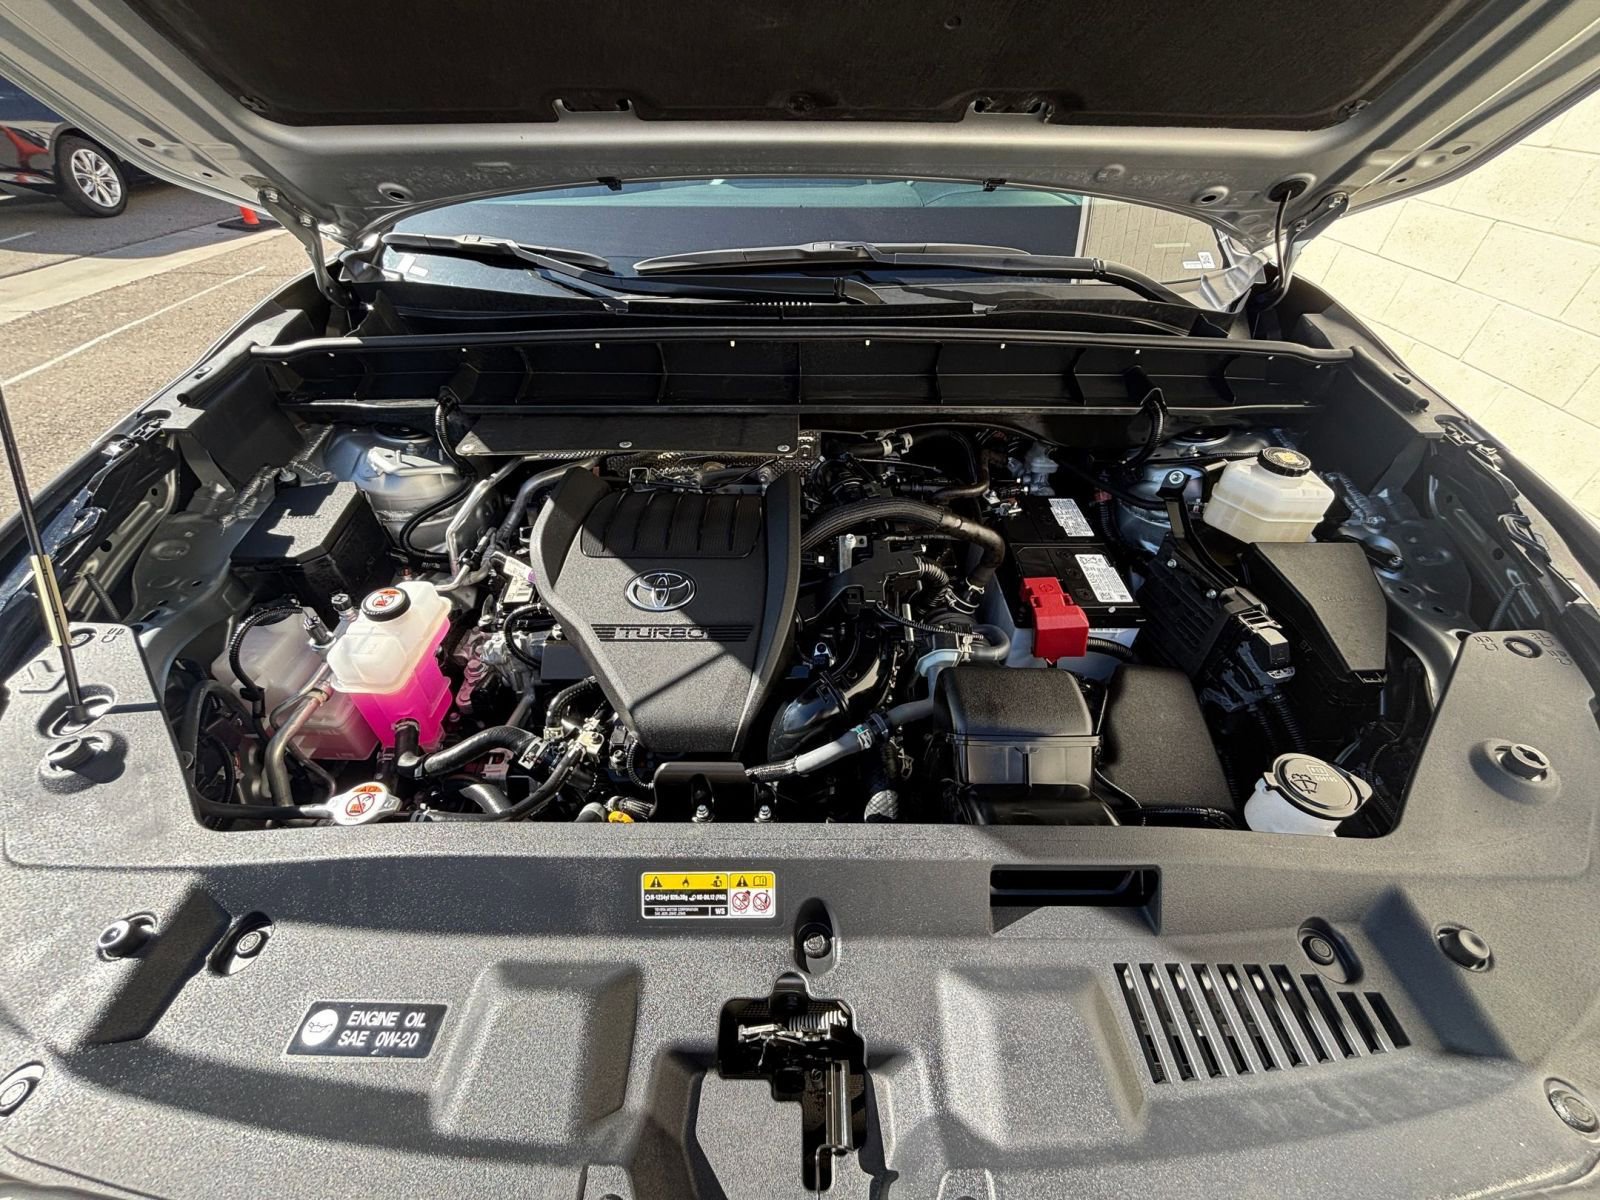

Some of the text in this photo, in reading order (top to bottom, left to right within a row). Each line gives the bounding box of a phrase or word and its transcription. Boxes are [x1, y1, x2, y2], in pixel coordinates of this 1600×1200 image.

[618, 627, 705, 638] TURBO
[346, 1010, 427, 1027] ENGINE OIL
[337, 1030, 420, 1048] SAE 0W-20
